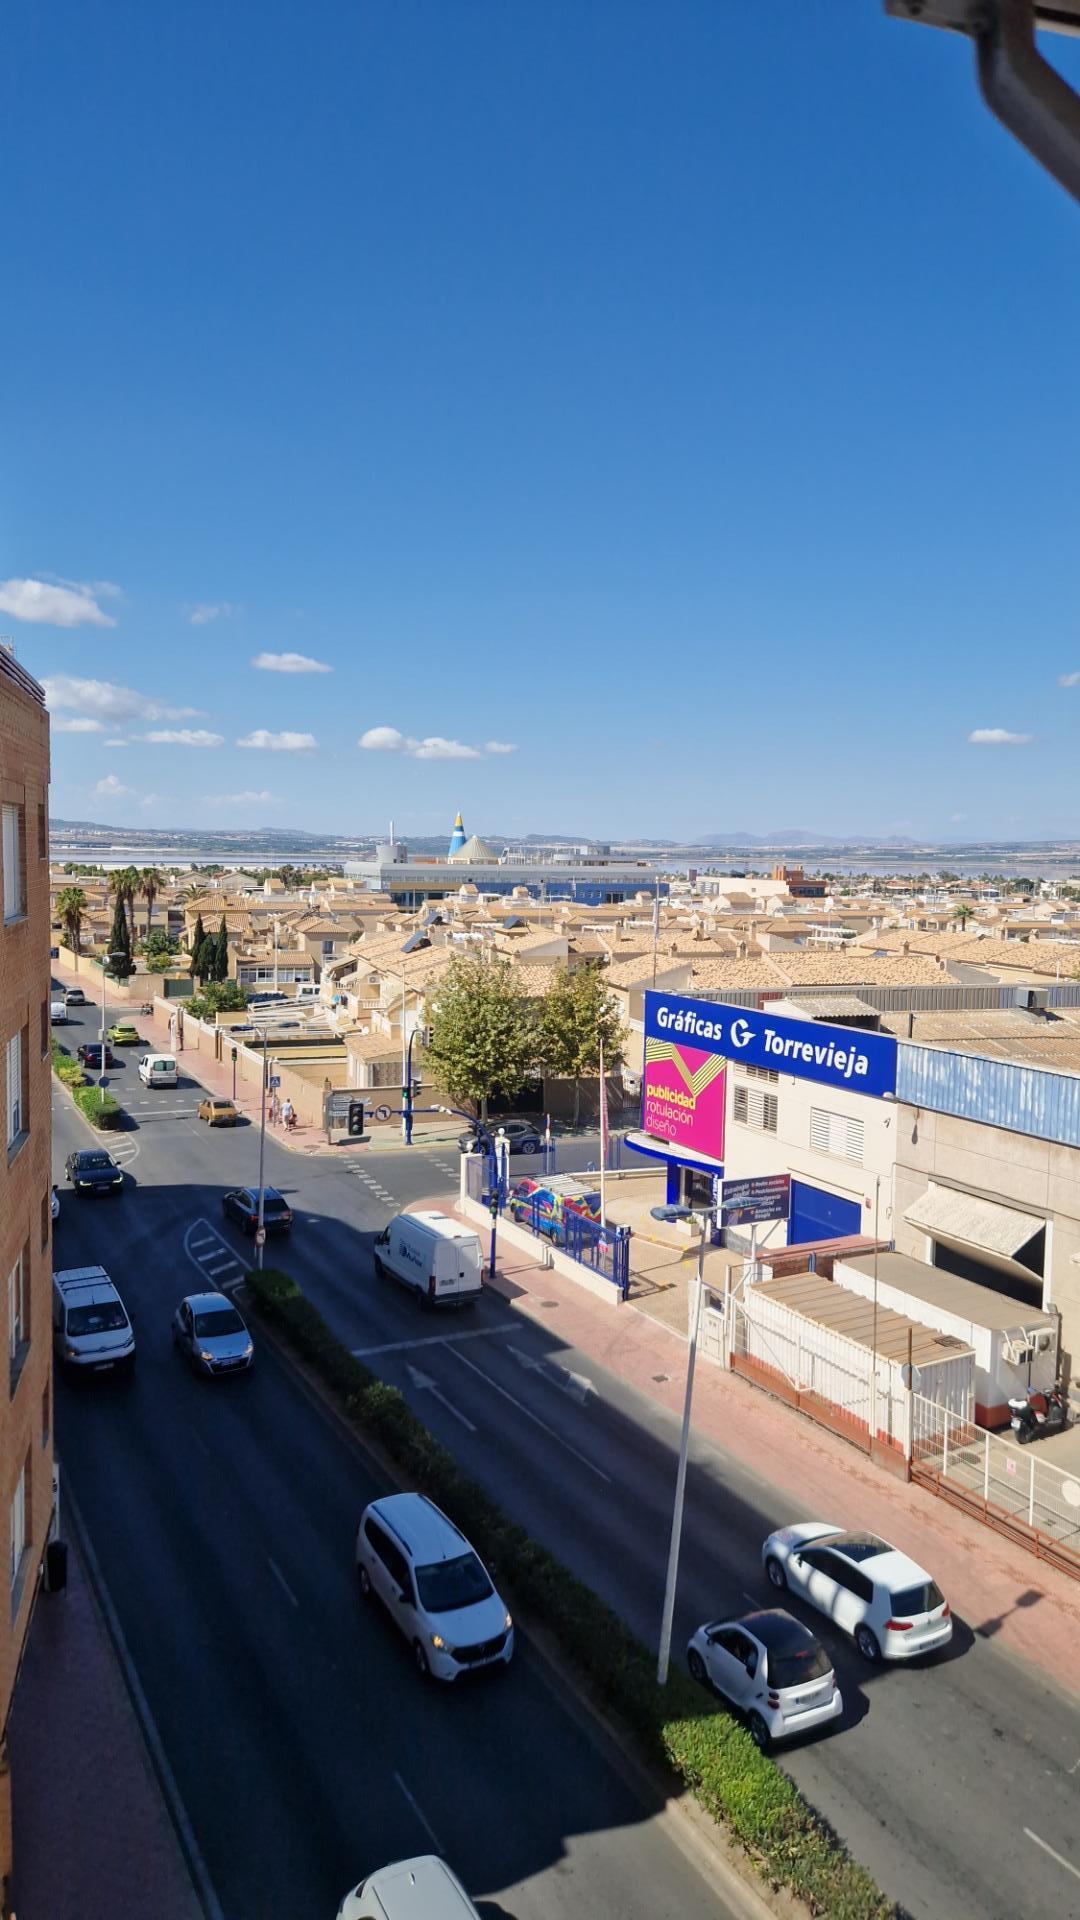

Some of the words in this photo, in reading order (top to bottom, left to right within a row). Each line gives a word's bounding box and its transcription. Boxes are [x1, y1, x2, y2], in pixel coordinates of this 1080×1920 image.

[657, 1007, 722, 1040] Gráficas
[764, 1029, 869, 1078] Torrevieja
[646, 1083, 696, 1110] publicidad
[646, 1100, 693, 1127] rotulación
[646, 1115, 676, 1136] diseño
